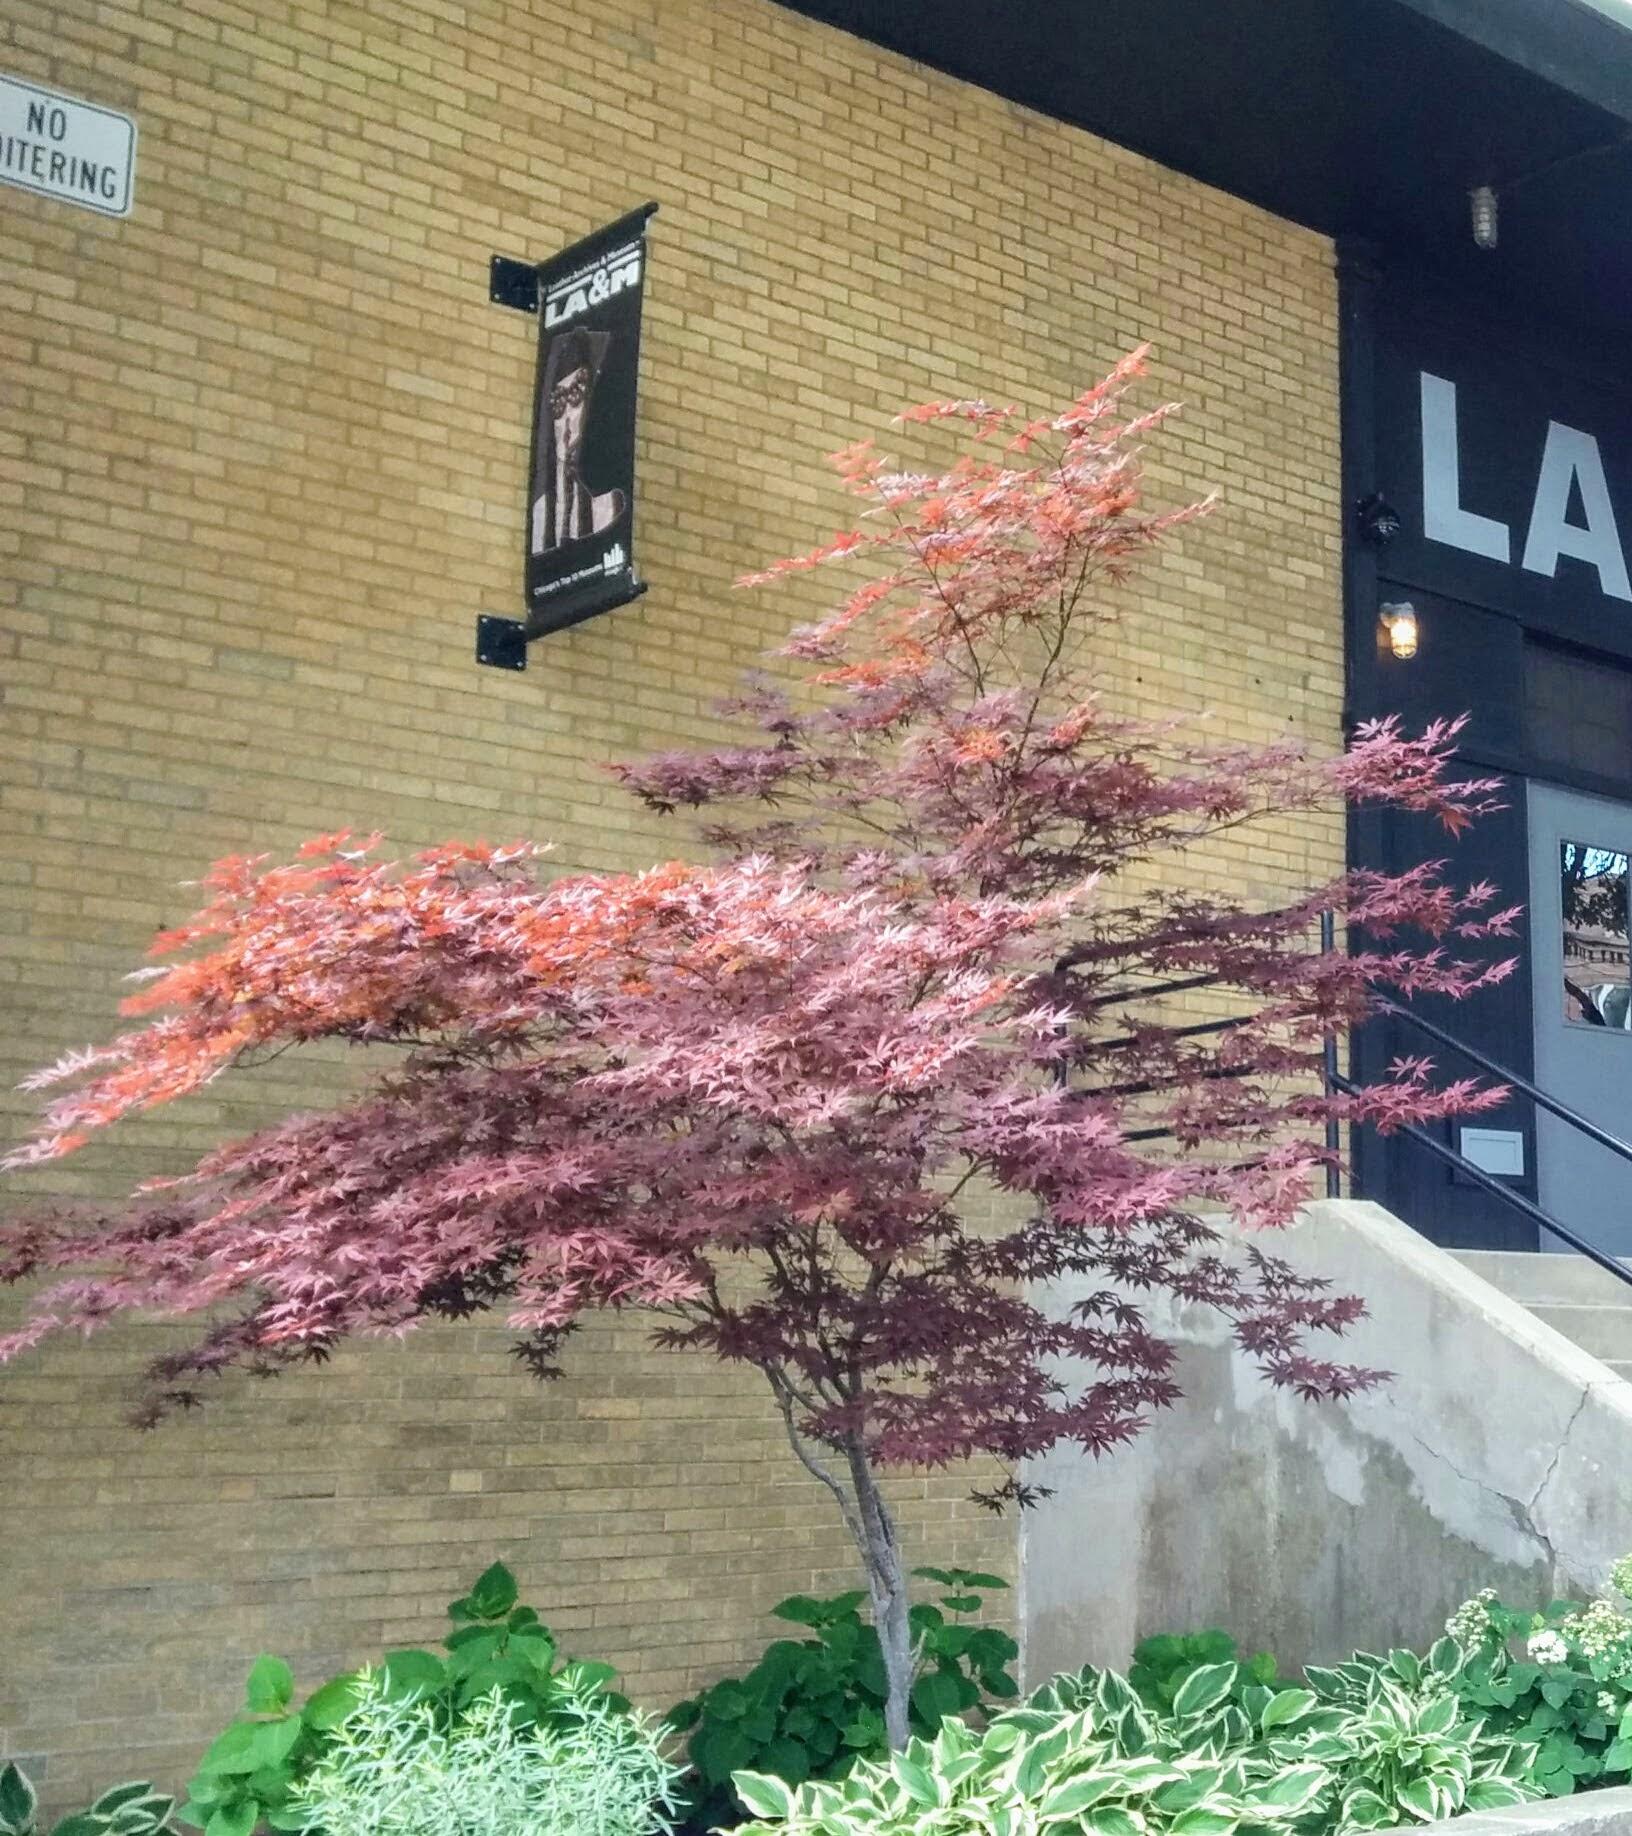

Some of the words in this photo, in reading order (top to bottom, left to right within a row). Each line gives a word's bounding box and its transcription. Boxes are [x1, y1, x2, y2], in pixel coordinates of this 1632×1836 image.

[27, 102, 67, 141] NO
[0, 135, 117, 199] ITERING
[544, 259, 641, 329] LA&M
